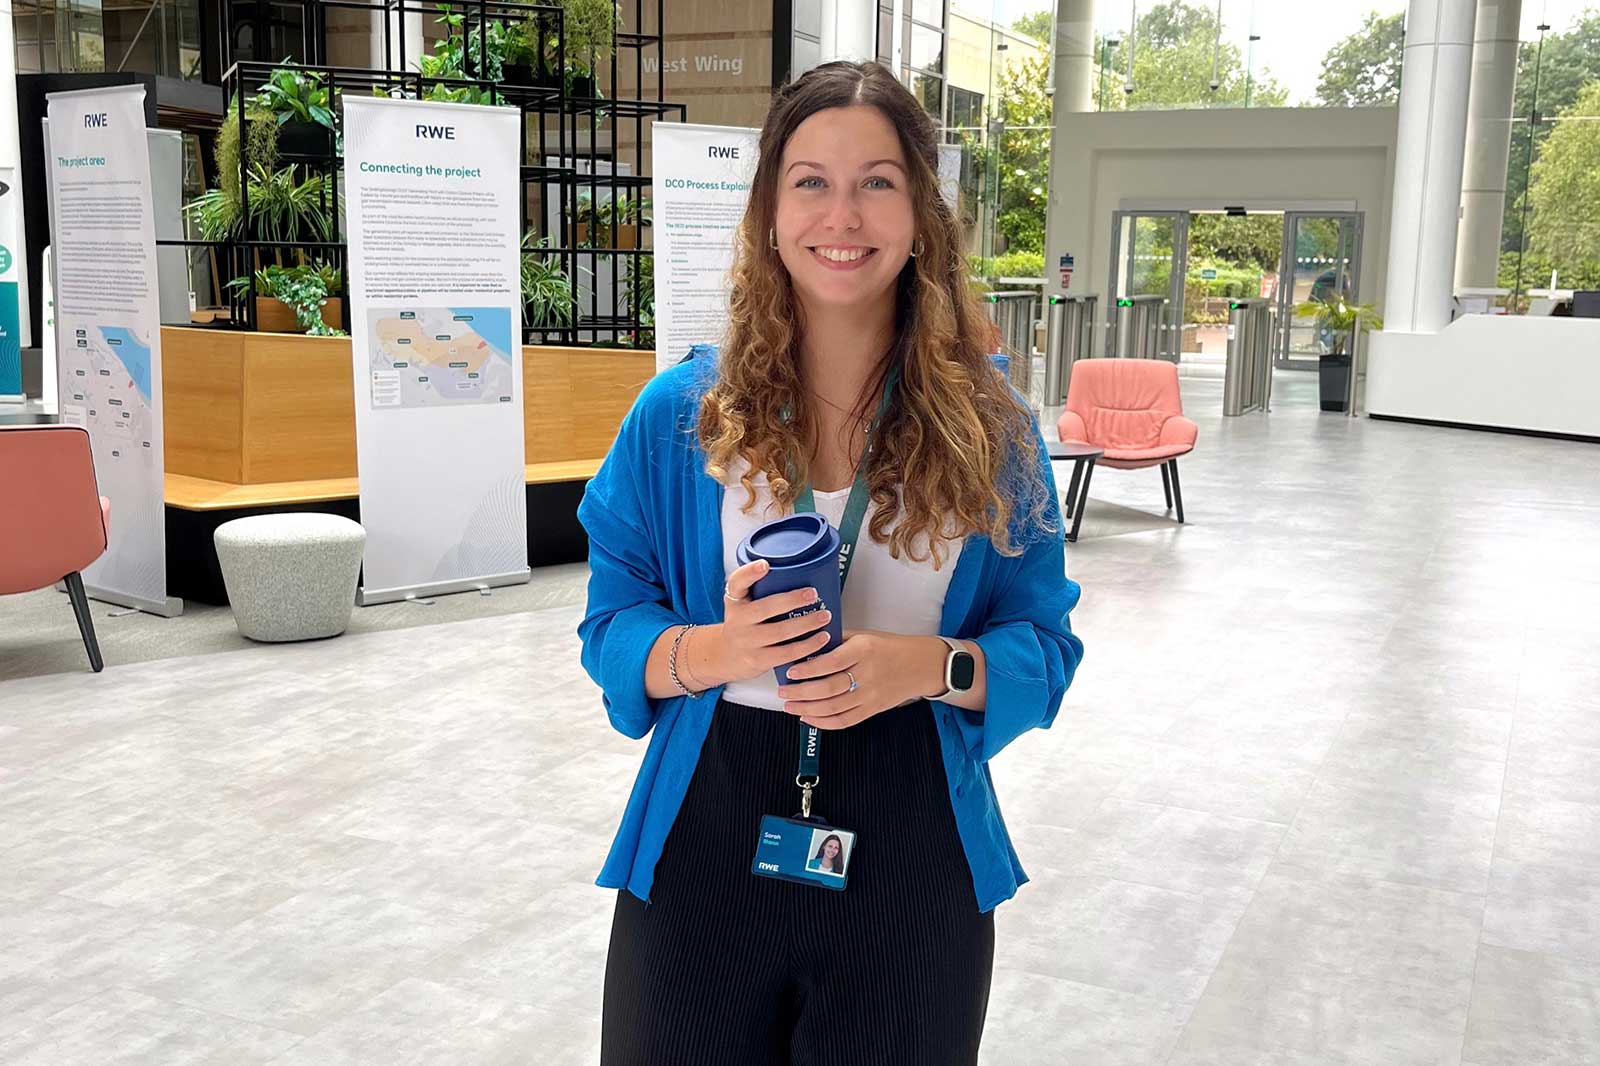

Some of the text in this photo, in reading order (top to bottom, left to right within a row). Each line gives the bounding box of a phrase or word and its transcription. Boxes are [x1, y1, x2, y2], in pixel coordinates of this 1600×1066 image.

[642, 54, 743, 75] West Wing
[84, 113, 108, 128] RWE
[416, 124, 455, 140] RWE
[708, 146, 740, 159] RWE
[58, 155, 106, 168] The project area
[360, 162, 481, 179] Connecting the project
[665, 179, 685, 188] DCO
[686, 180, 719, 190] Process
[838, 544, 851, 576] WE
[807, 727, 818, 757] RWE
[764, 831, 781, 840] Sarah
[758, 862, 780, 872] RWE
